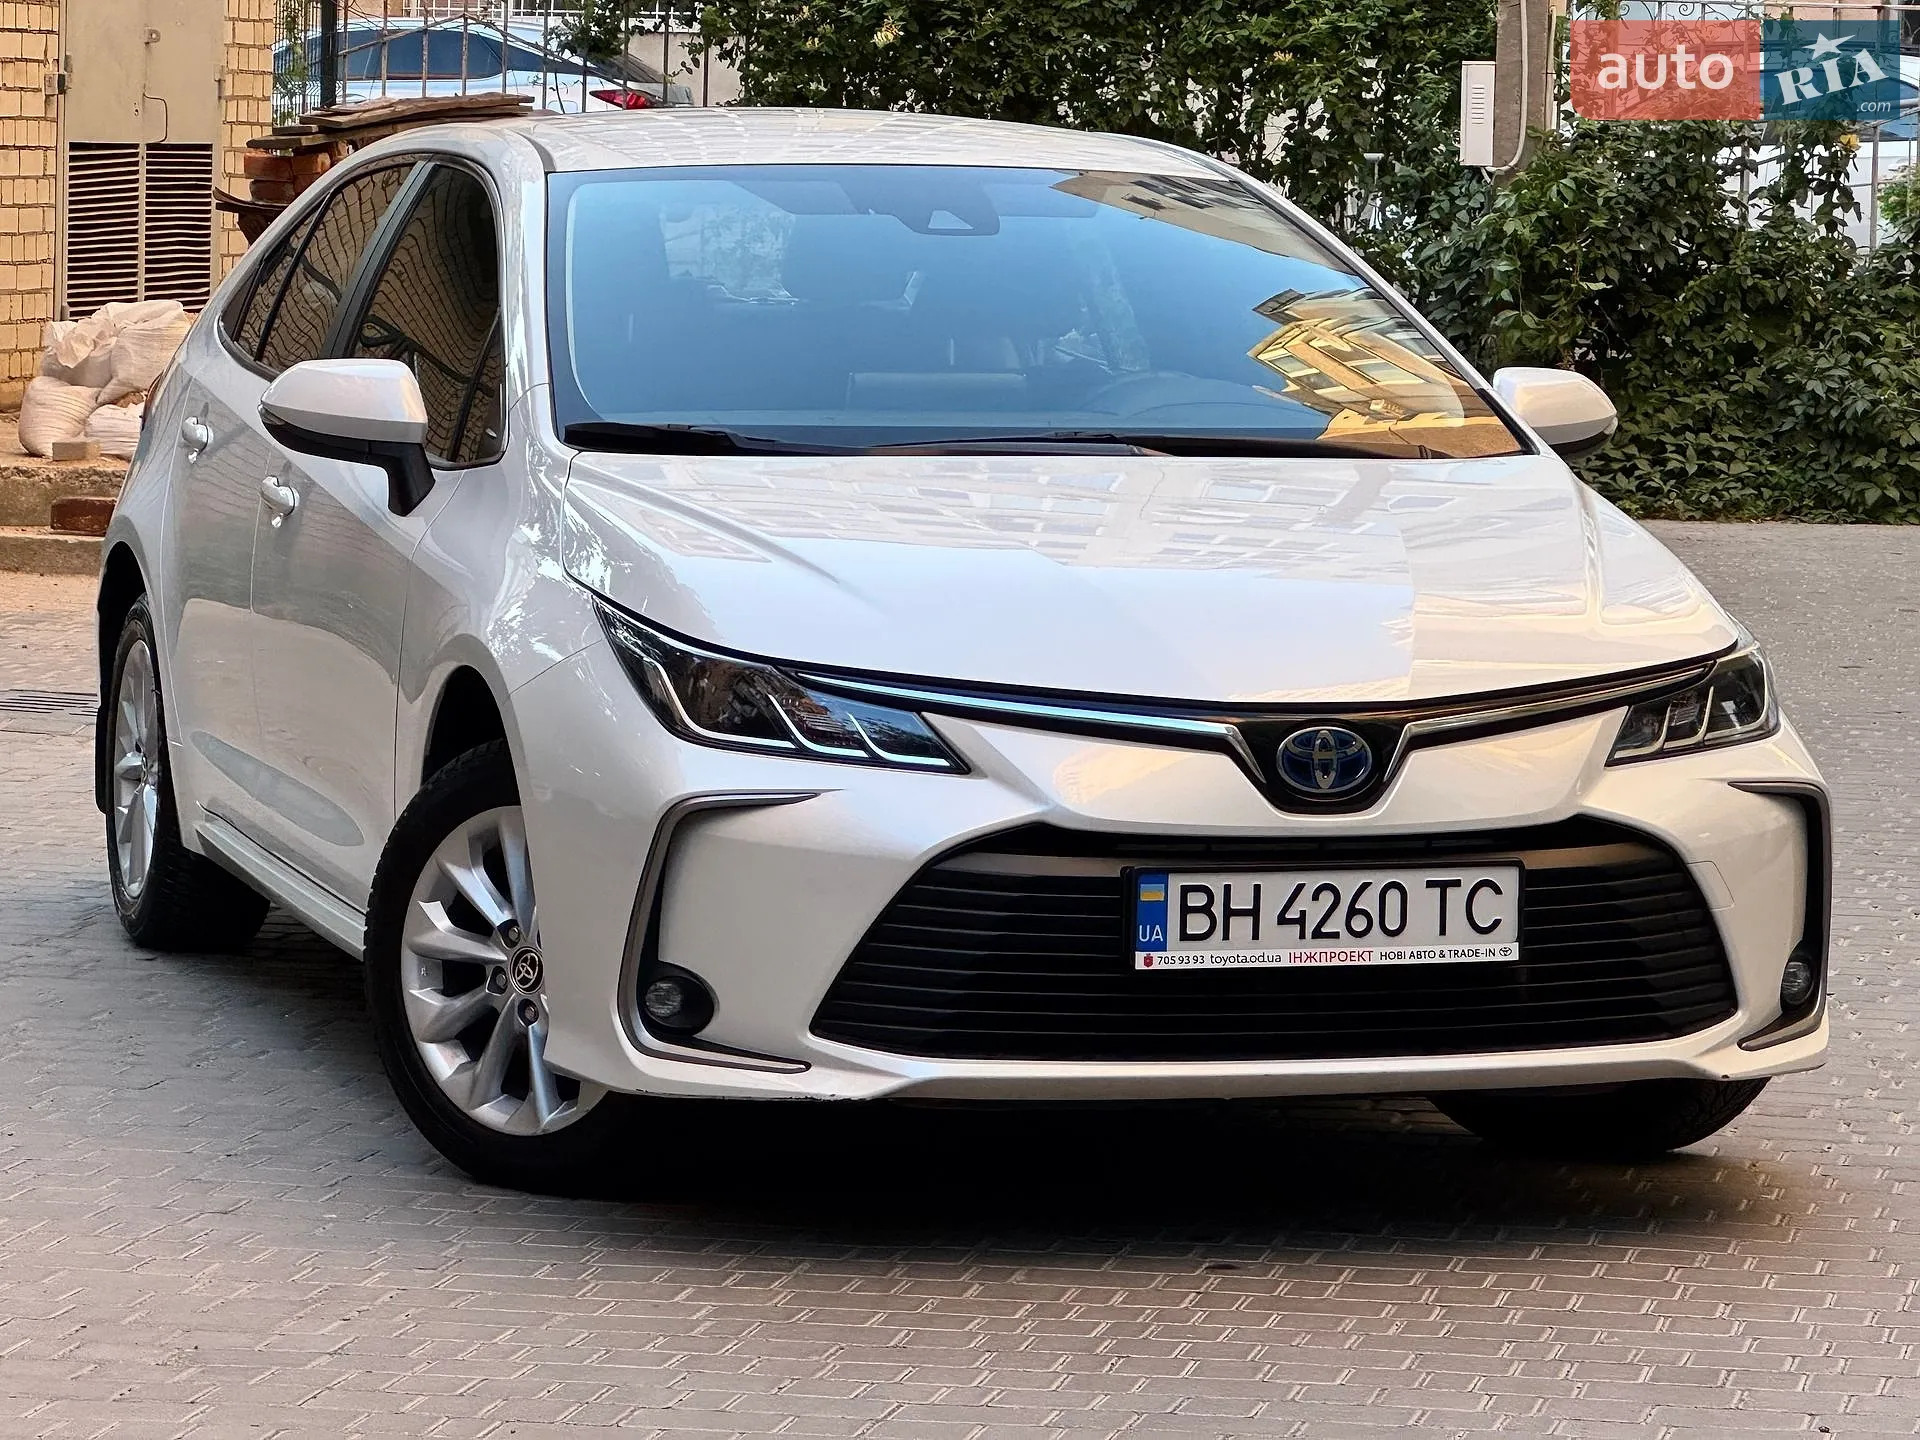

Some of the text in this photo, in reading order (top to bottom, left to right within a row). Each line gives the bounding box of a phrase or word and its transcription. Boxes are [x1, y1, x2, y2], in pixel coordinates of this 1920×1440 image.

[1179, 878, 1503, 942] BH 4260 TC
[1138, 924, 1164, 943] UA
[1157, 948, 1496, 966] 705 93 93 toyota.od.ua ІНЖПРОЕКТ НОВІ АВТО & TRADE-IN
